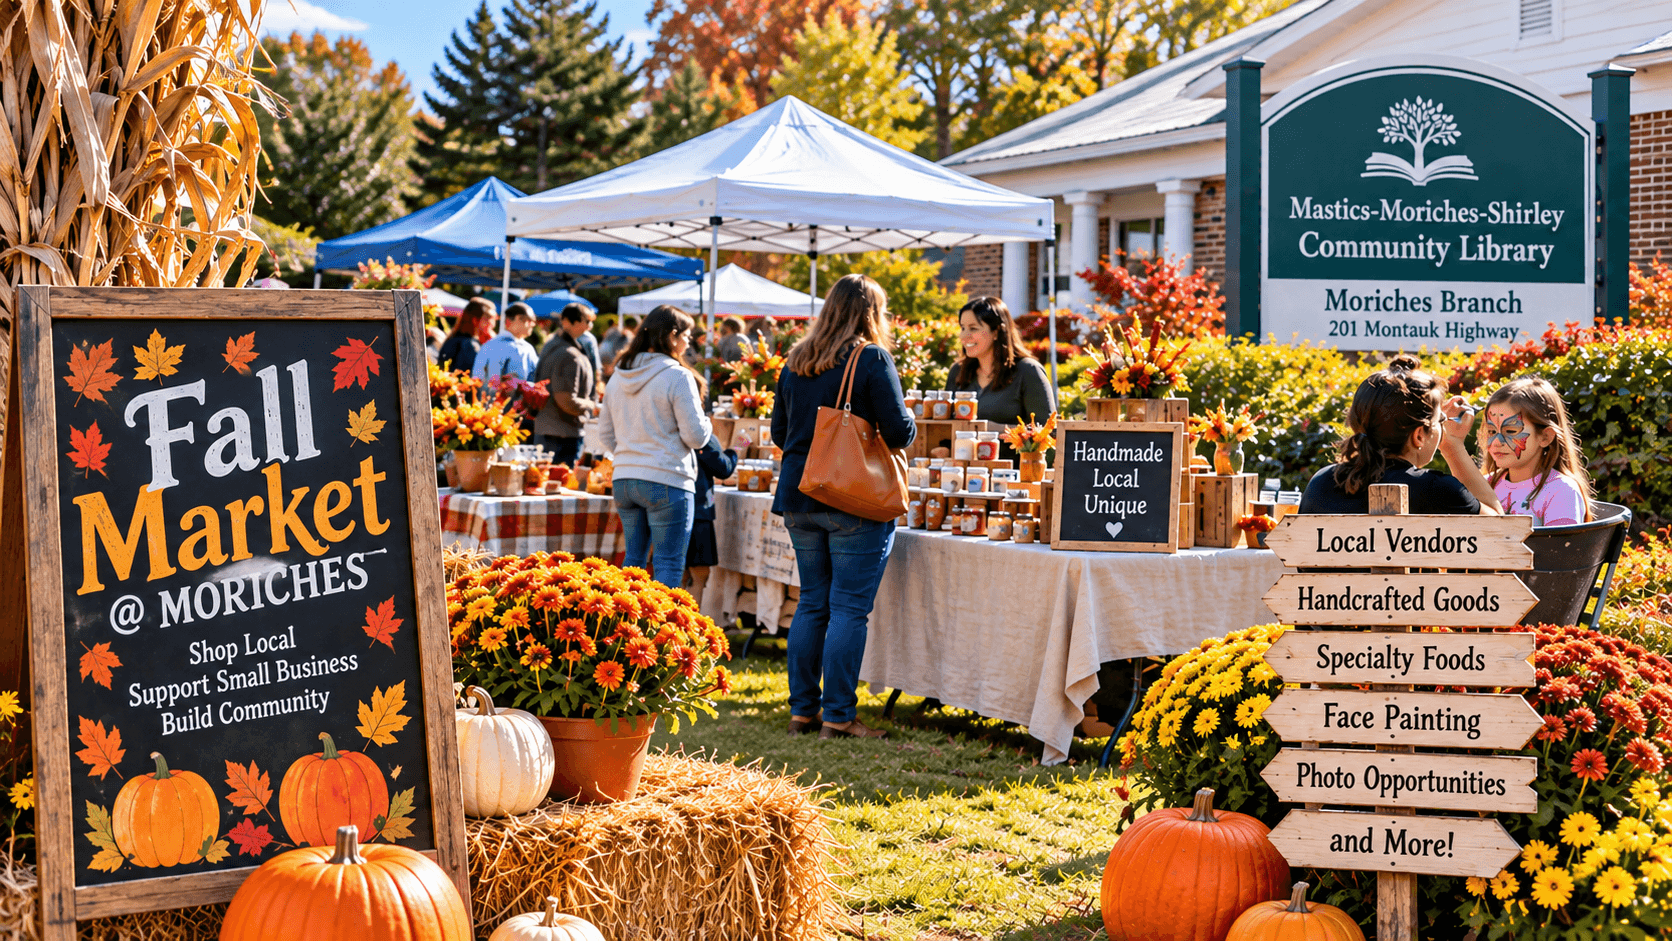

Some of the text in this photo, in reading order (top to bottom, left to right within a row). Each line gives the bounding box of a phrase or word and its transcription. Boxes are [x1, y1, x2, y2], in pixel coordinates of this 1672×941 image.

[1290, 197, 1564, 231] Mastics-Moriches-Shirley
[1298, 231, 1554, 268] Community Library
[1324, 289, 1523, 314] Moriches Branch
[1329, 320, 1519, 343] 201 Montauk Highway
[124, 358, 322, 493] Fall
[1073, 440, 1163, 463] Handmade
[1092, 468, 1140, 488] Local
[1084, 494, 1147, 520] Unique
[72, 455, 391, 596] Market
[1316, 527, 1478, 554] Local Vendors
[109, 552, 370, 635] @ MORICHES
[1297, 585, 1500, 613] Handcrafted Goods
[189, 626, 297, 665] Shop Local
[1316, 643, 1486, 676] Specialty Foods
[129, 654, 359, 708] Support Small Business
[161, 689, 330, 736] Build Community
[1323, 702, 1481, 740] Face Painting
[1296, 762, 1506, 798] Photo Opportunities
[1329, 827, 1455, 859] and More!
